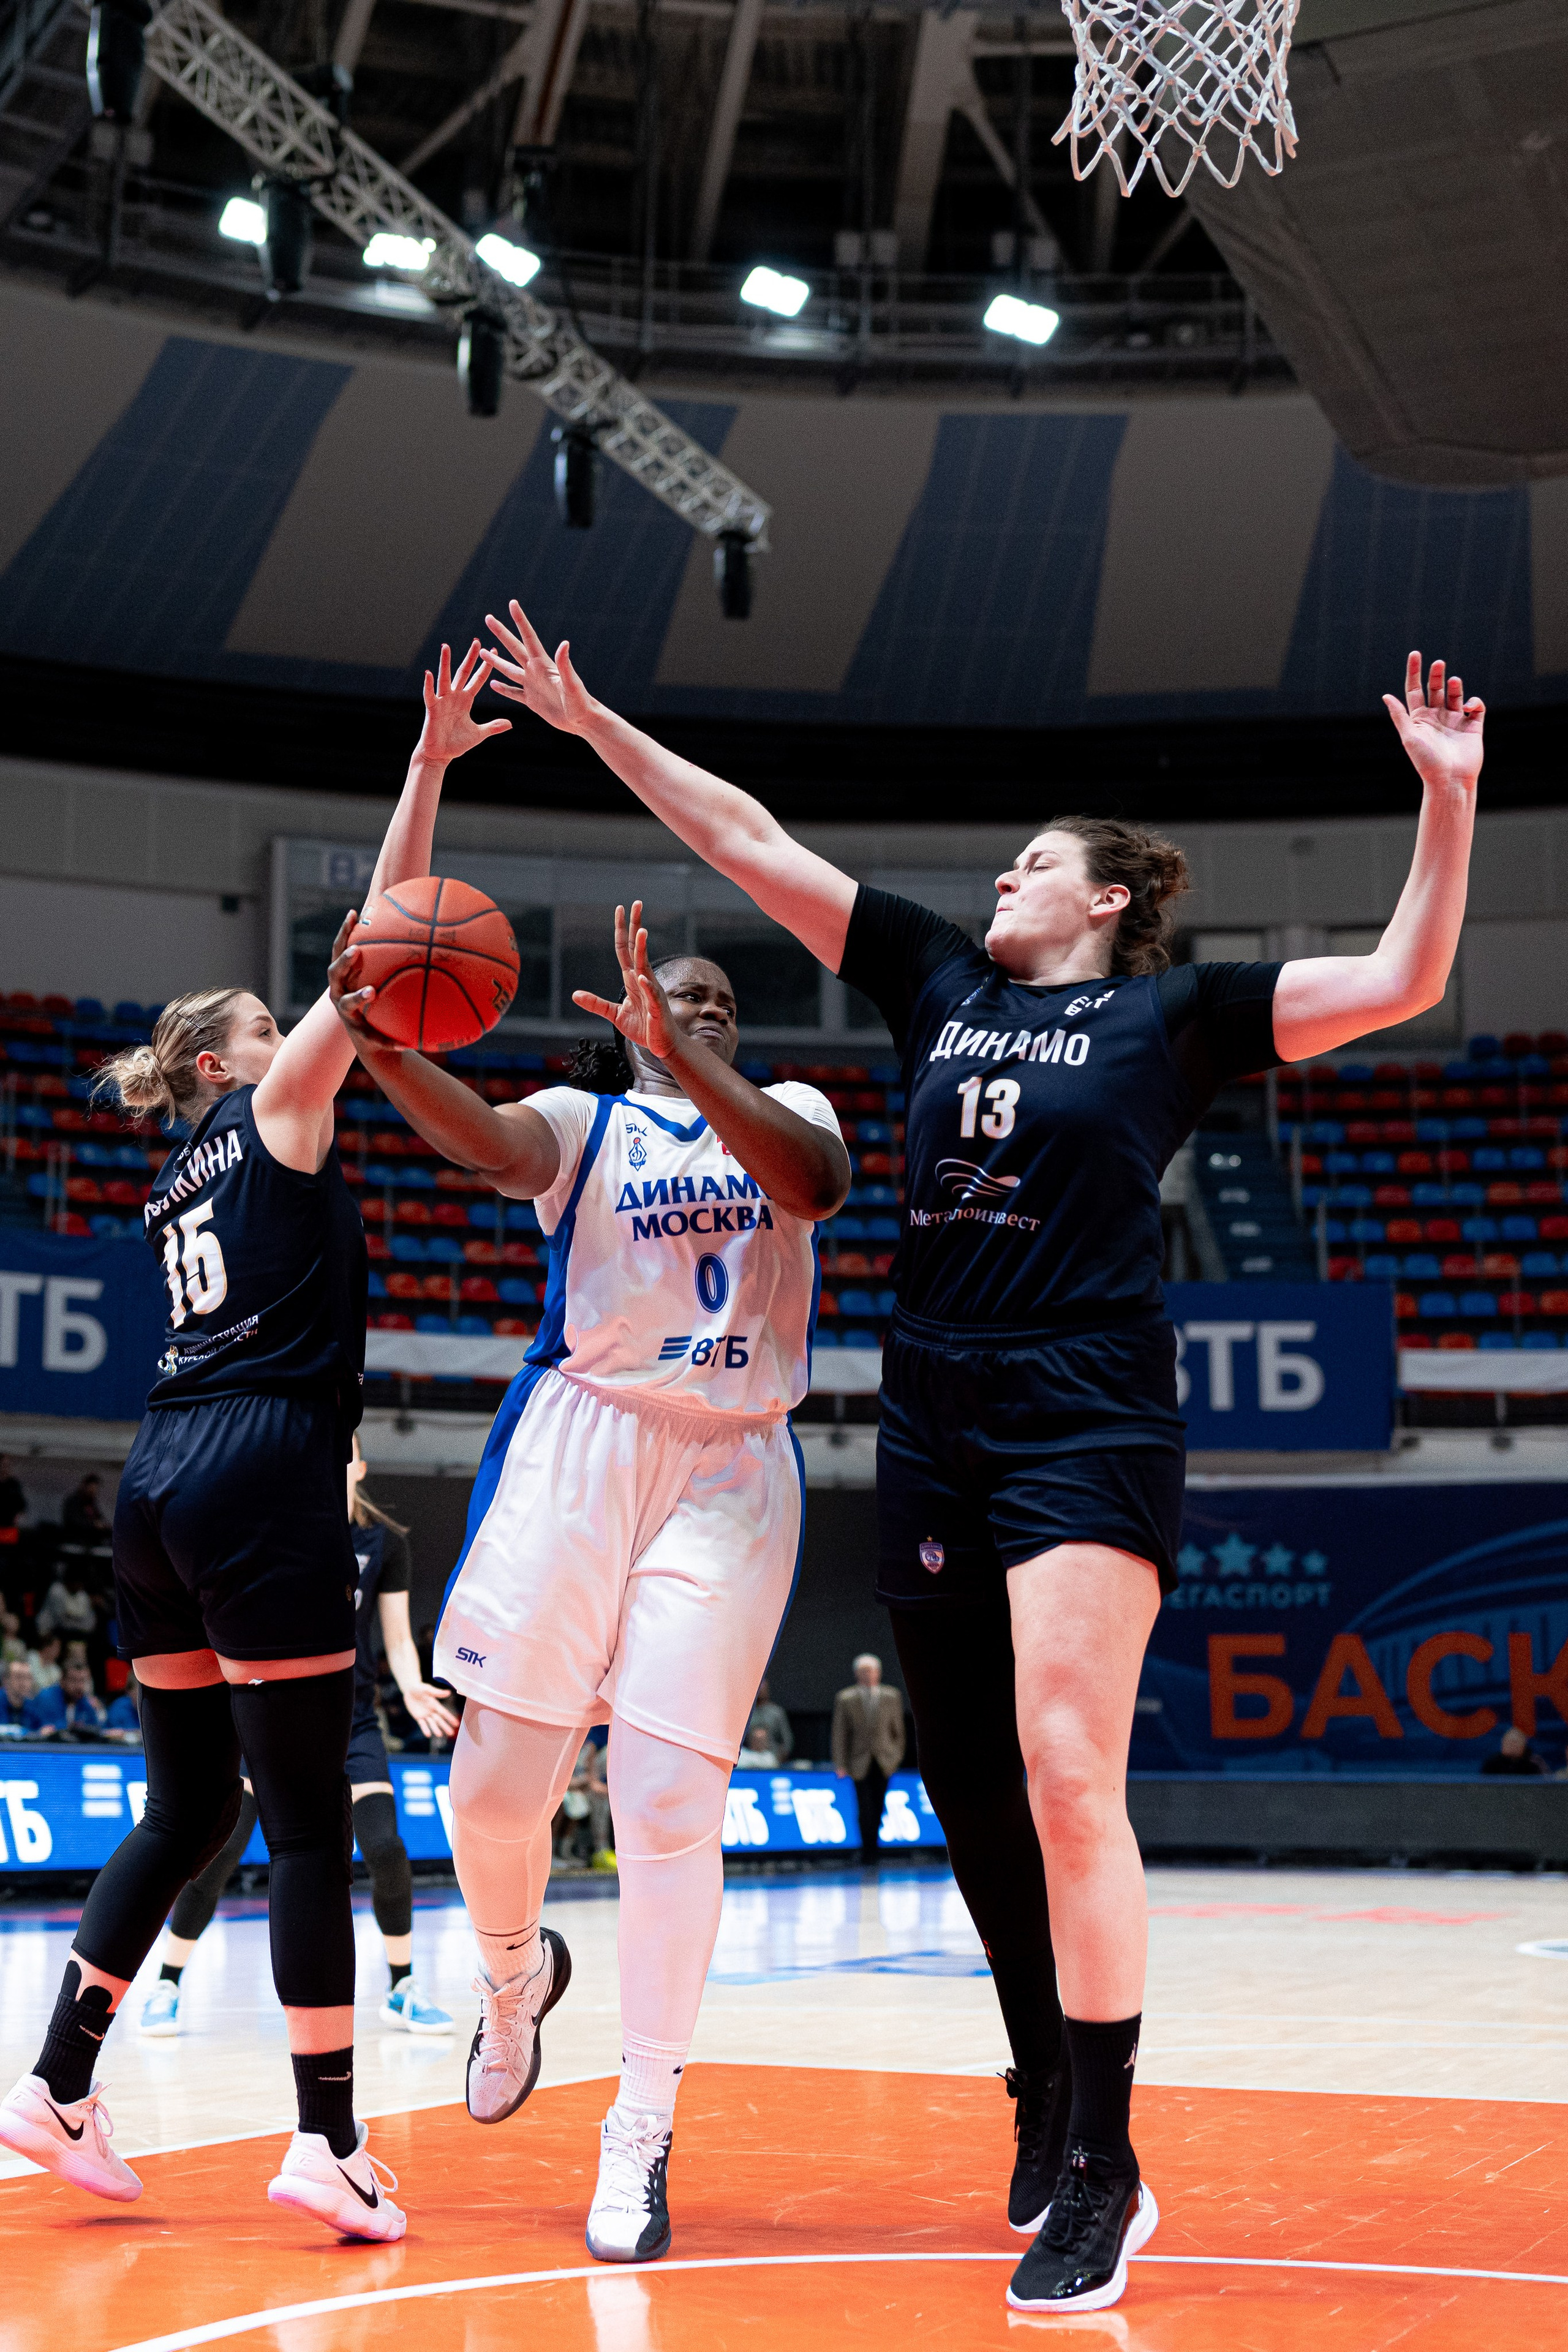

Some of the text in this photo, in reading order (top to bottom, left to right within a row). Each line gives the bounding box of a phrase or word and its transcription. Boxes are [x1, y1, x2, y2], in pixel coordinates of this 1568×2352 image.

[929, 1020, 1091, 1066] ДИНАМО
[957, 1076, 1021, 1140] 13
[615, 1172, 774, 1214] ДИНАМ
[631, 1204, 774, 1242] МОСКВА
[162, 1196, 228, 1330] 15
[695, 1253, 728, 1313] 0
[0, 1270, 108, 1374] ТБ
[692, 1335, 749, 1369] ВТБ
[1173, 1320, 1325, 1412] ТБ
[1164, 1581, 1332, 1610] ЕГАСПОРТ
[455, 1647, 487, 1668] STK
[1207, 1631, 1568, 1740] БАСК
